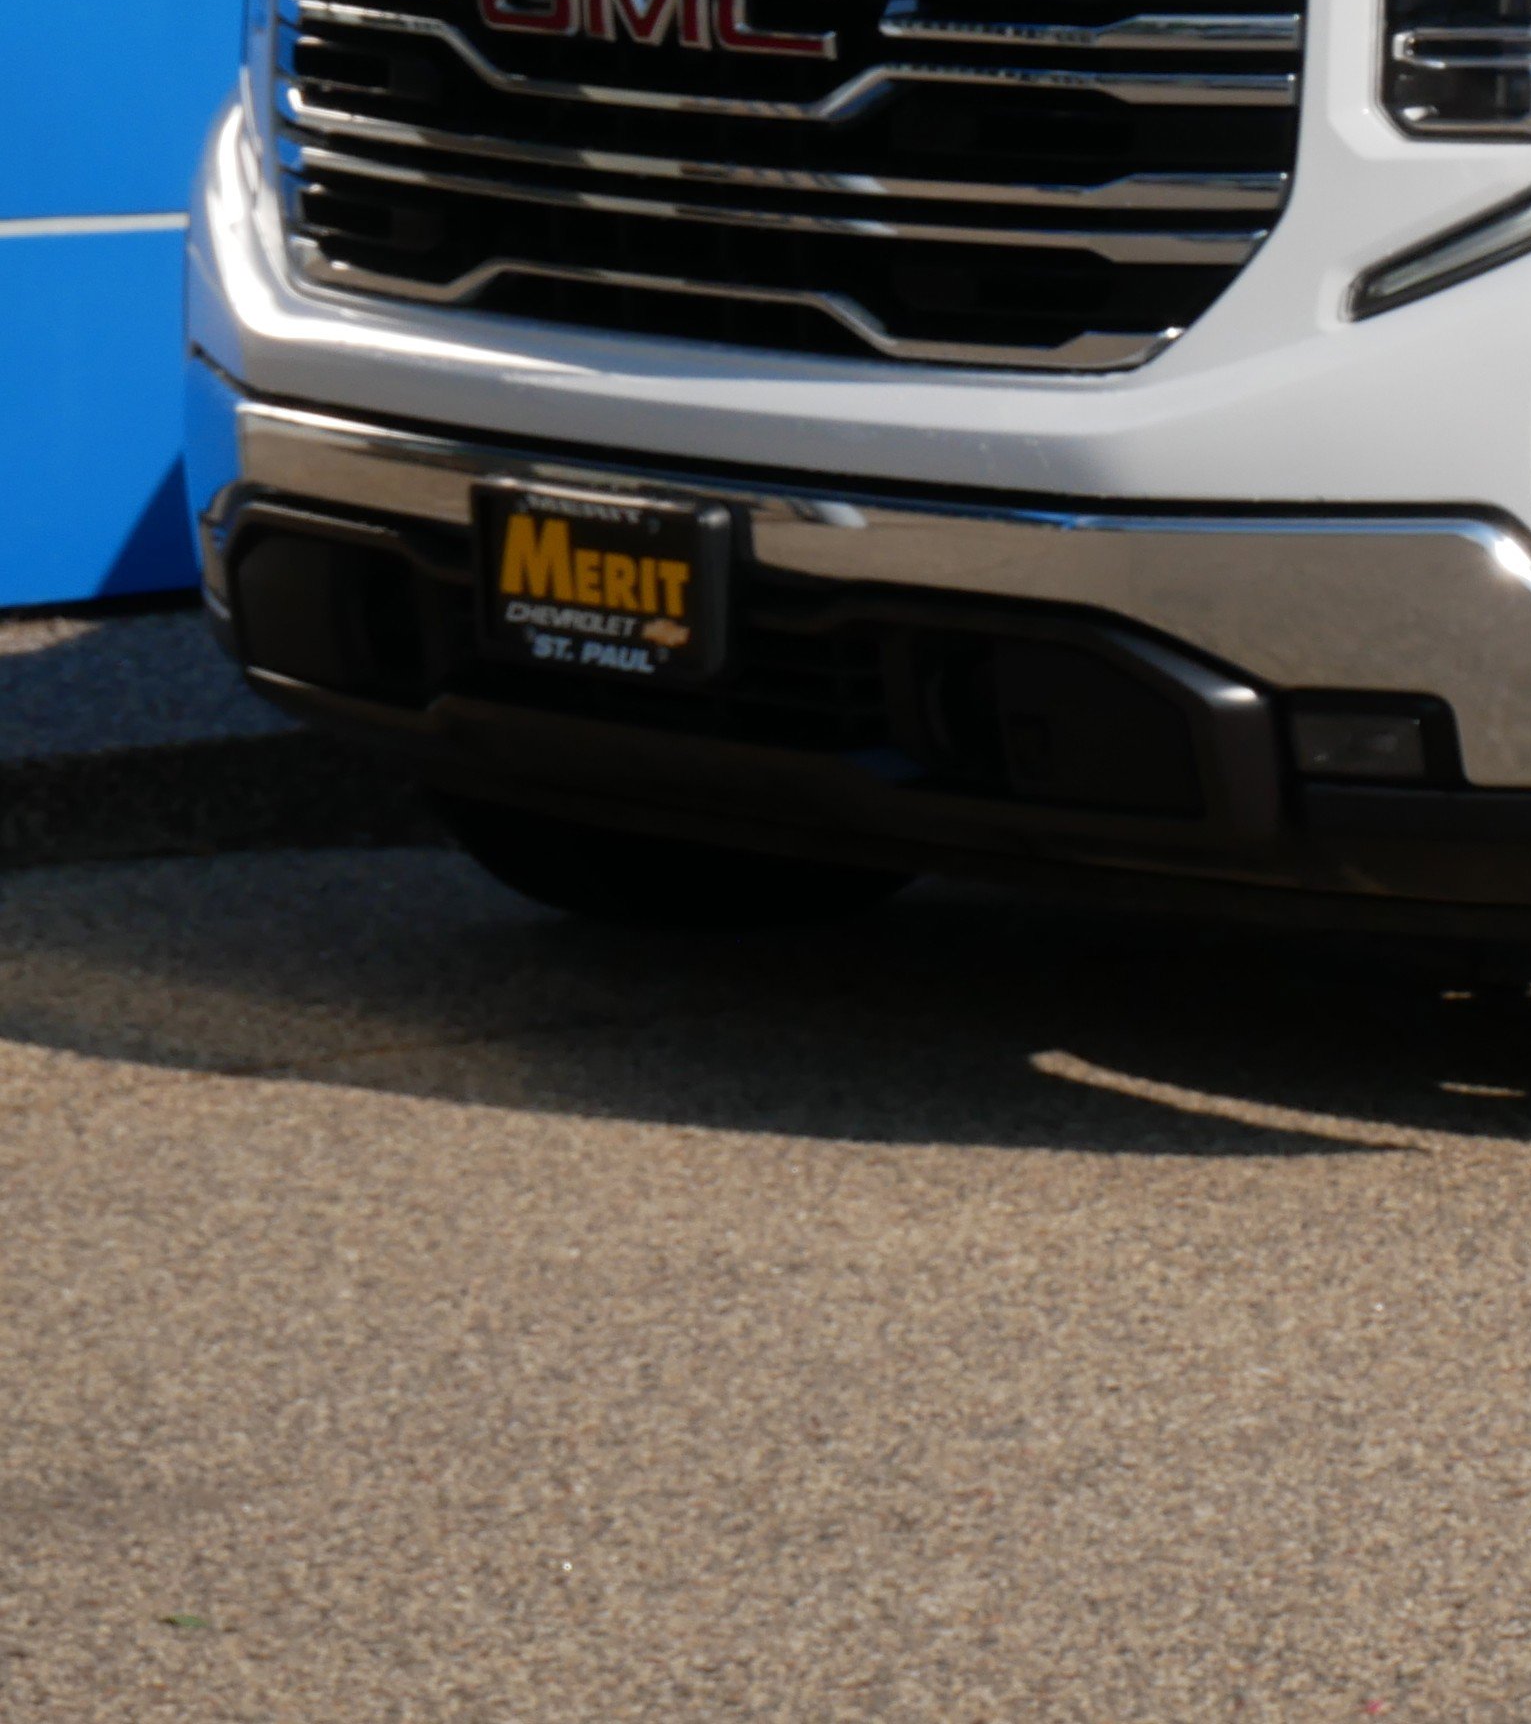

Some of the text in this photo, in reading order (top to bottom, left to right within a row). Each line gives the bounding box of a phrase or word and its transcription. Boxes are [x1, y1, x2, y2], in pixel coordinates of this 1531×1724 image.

[502, 513, 689, 617] MERIT
[532, 633, 656, 674] ST. PAUL
